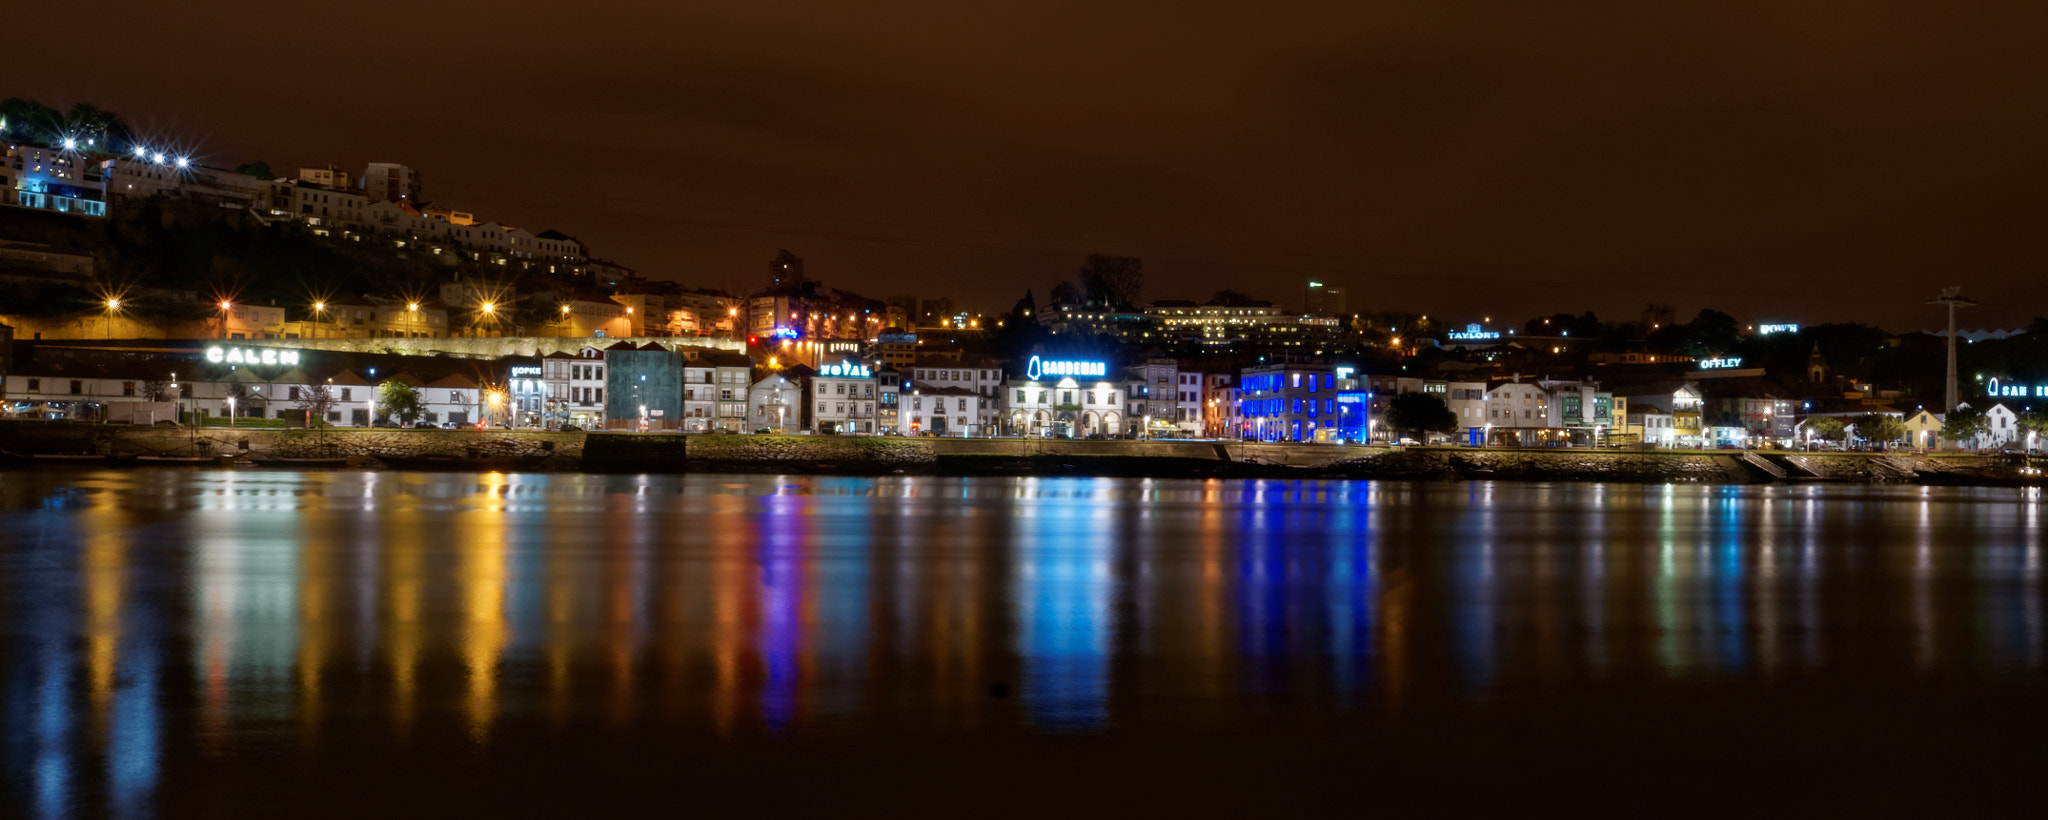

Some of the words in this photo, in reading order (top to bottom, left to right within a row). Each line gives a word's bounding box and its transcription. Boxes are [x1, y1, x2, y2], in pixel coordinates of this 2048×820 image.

[1448, 331, 1500, 340] TAYLOR'S
[1042, 360, 1105, 376] SANDEMAN
[1700, 357, 1742, 369] OFFLEY
[820, 363, 870, 377] NOVAL
